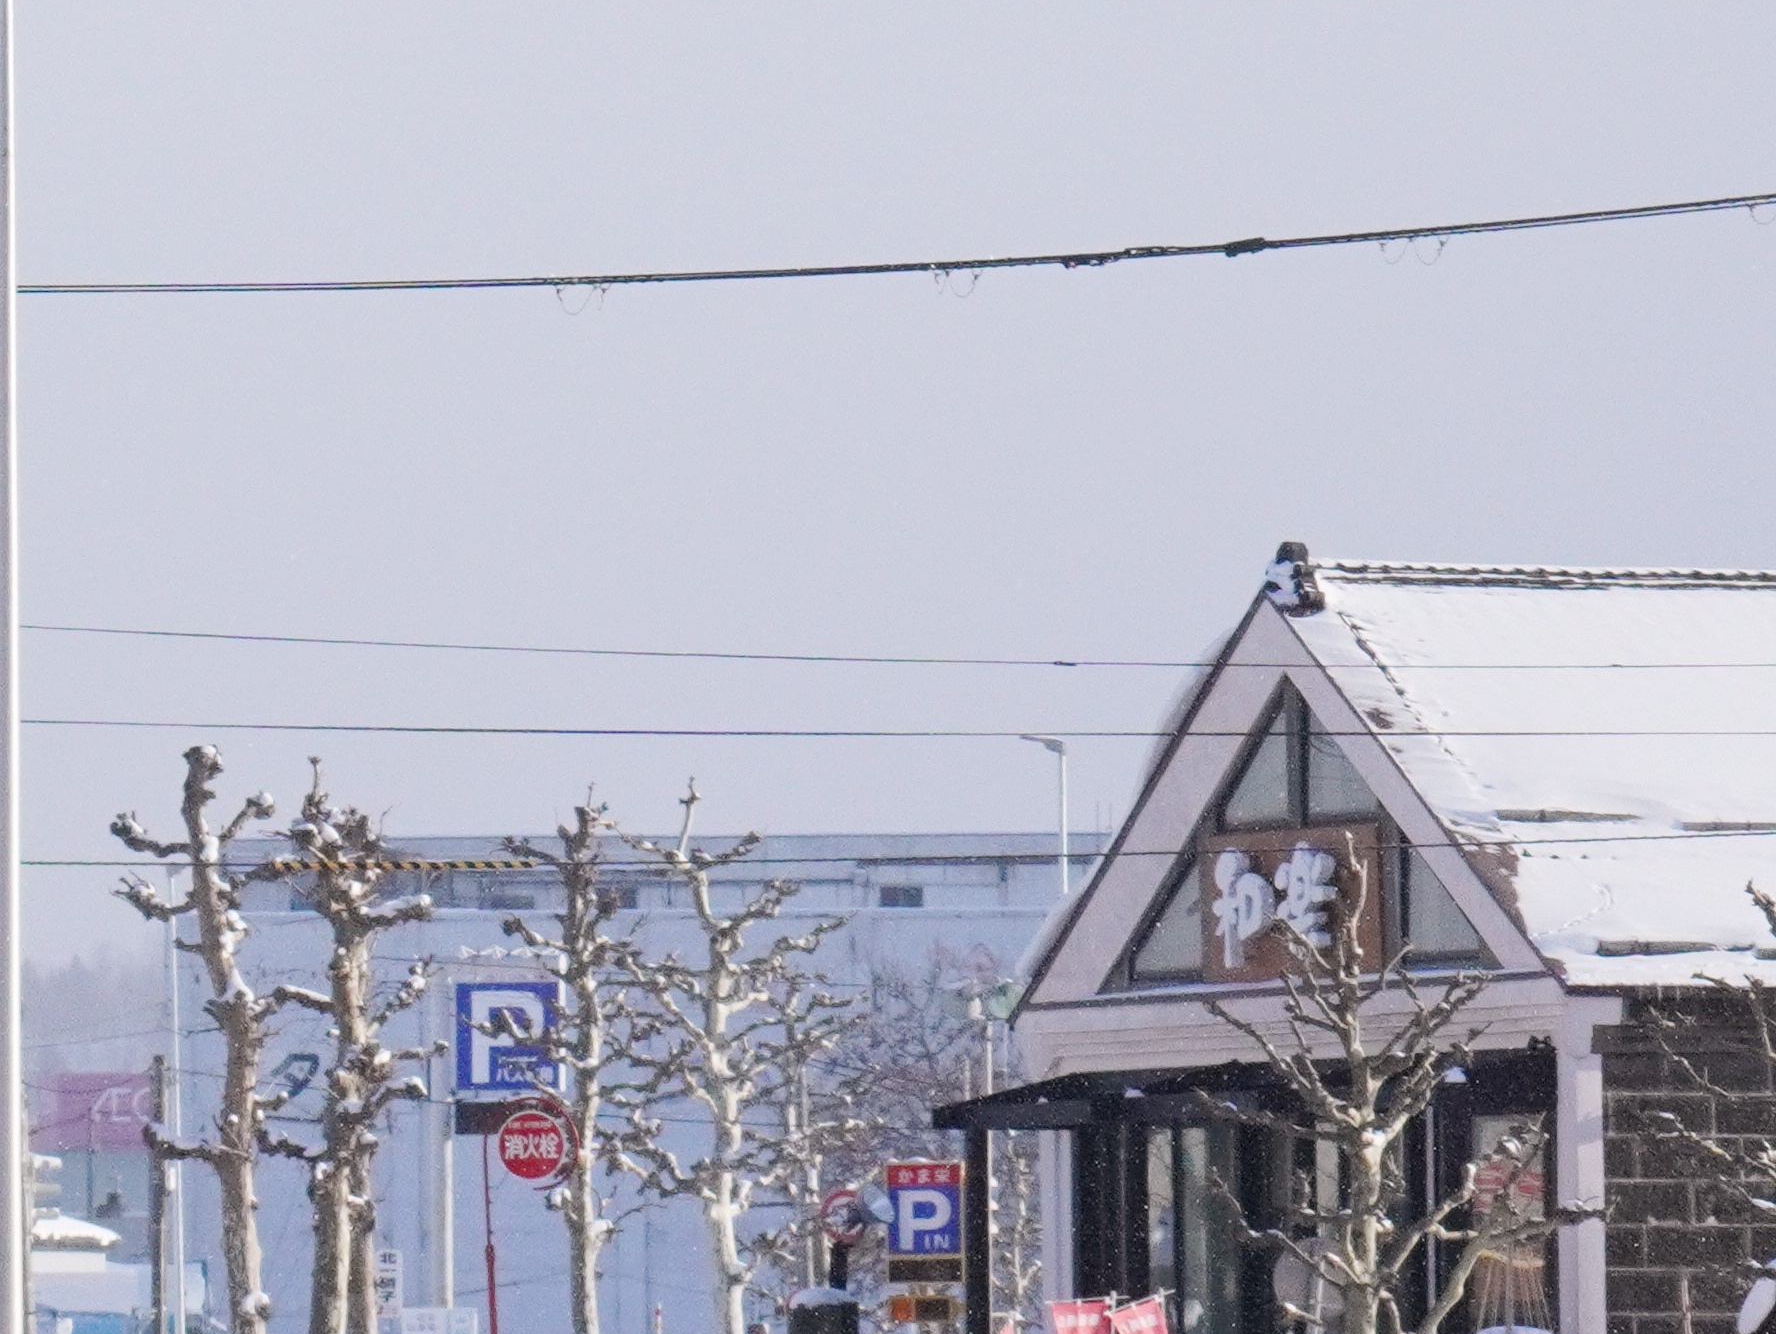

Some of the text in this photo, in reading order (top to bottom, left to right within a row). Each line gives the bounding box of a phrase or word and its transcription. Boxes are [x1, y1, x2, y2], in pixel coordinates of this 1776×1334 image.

[471, 990, 545, 1084] P
[503, 1134, 560, 1160] 消火栓
[898, 1190, 952, 1251] P
[924, 1233, 950, 1248] IN
